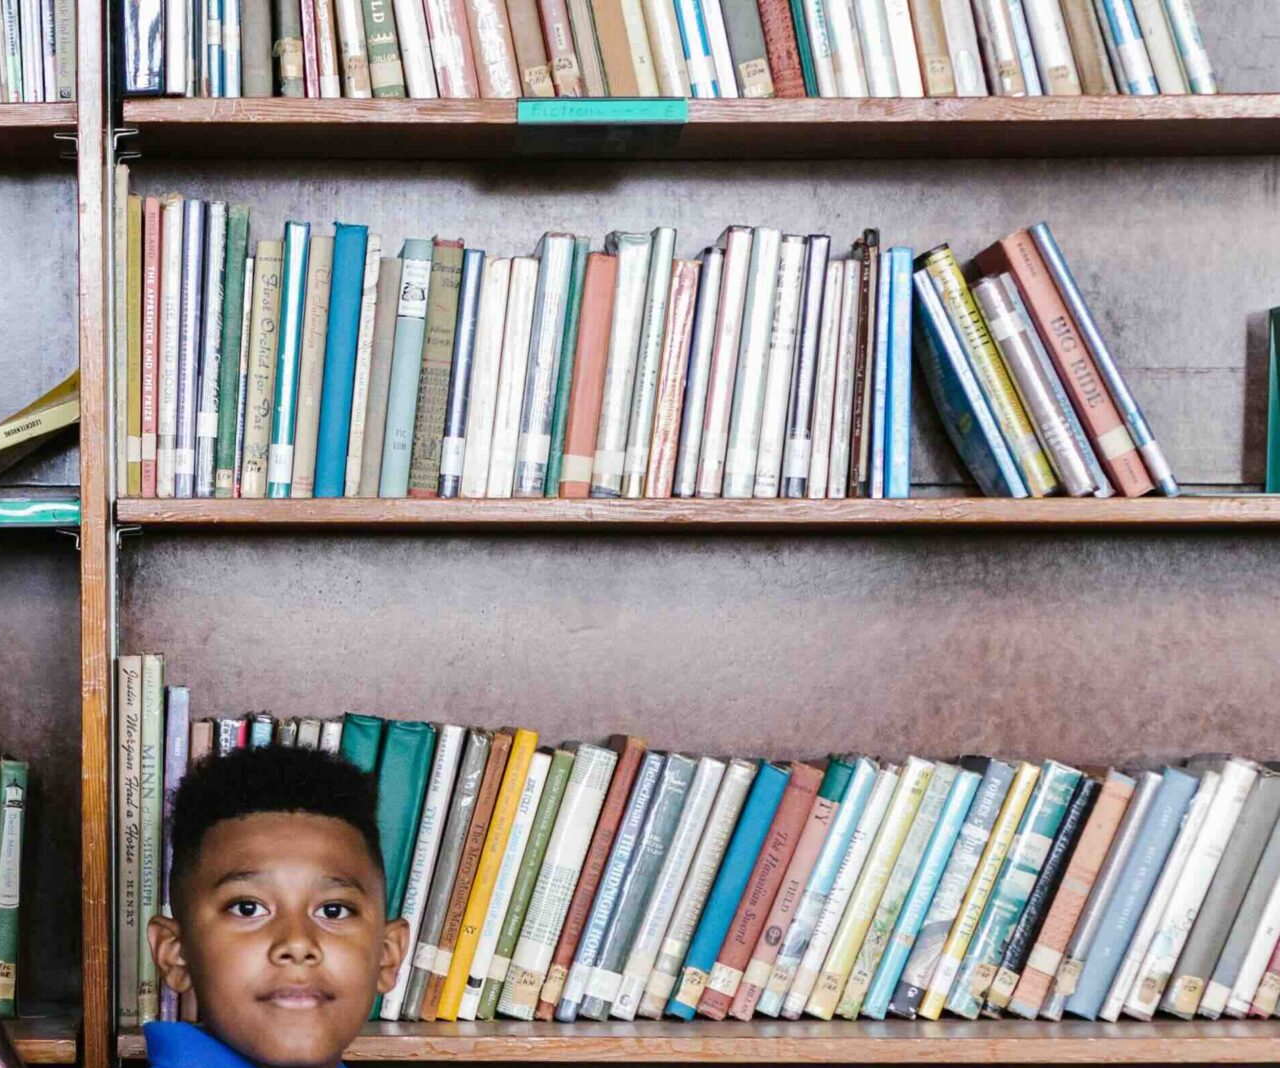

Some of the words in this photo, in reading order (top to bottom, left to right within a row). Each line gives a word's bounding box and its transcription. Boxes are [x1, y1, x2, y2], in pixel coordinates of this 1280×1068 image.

[147, 266, 156, 285] THE
[315, 264, 332, 296] The
[262, 273, 278, 312] First
[145, 288, 155, 344] APPRENTICE
[145, 349, 153, 369] AND
[257, 318, 275, 367] Orchid
[1049, 315, 1075, 352] BIG
[1069, 359, 1104, 409] RIDE
[255, 373, 271, 394] for
[144, 395, 152, 422] PRIZE
[253, 401, 269, 430] Pat
[122, 668, 139, 706] Justin
[122, 713, 138, 770] Morgan
[141, 743, 155, 800] MINN
[126, 777, 138, 807] Had
[628, 759, 662, 828] Fleischman
[125, 823, 138, 864] Horse
[472, 823, 486, 843] The
[618, 833, 636, 857] THE
[771, 832, 788, 851] The
[142, 836, 152, 907] MISSISSIPPI
[461, 846, 479, 875] Merry
[454, 879, 471, 909] Music
[594, 861, 624, 925] MIDNIGHT
[748, 854, 780, 906] Hawaiian
[780, 880, 799, 912] FIELD
[125, 879, 134, 927] HENRY
[445, 912, 462, 943] Maker
[735, 910, 757, 945] Sword
